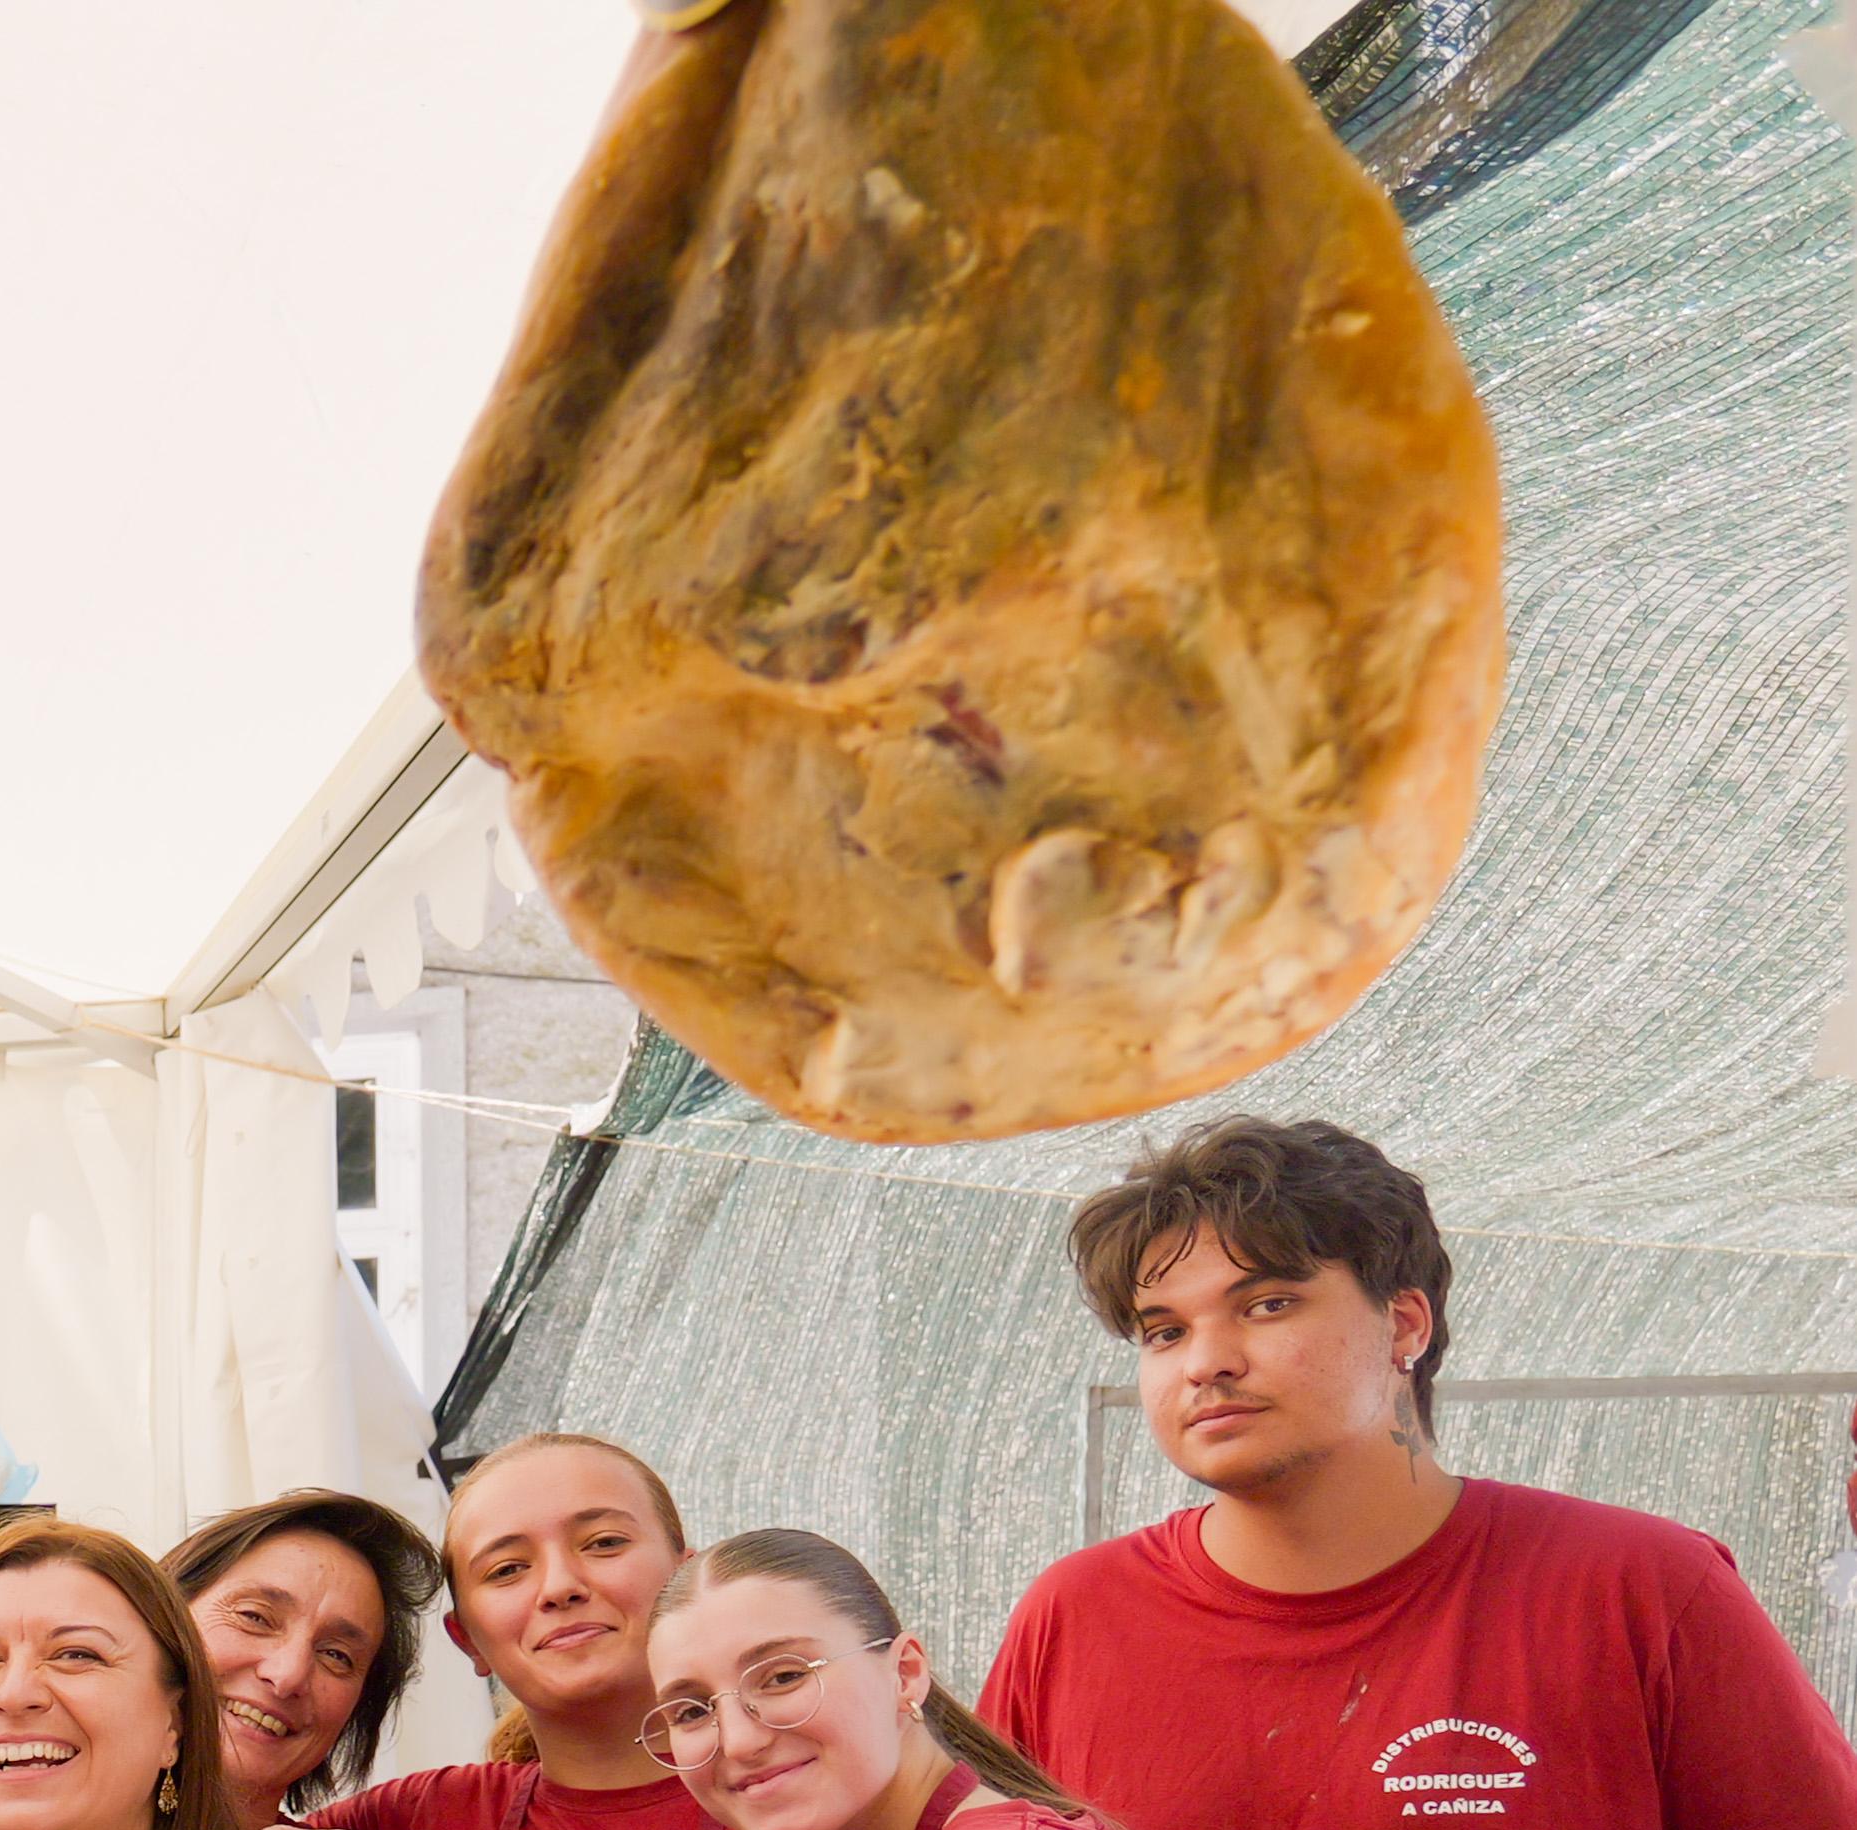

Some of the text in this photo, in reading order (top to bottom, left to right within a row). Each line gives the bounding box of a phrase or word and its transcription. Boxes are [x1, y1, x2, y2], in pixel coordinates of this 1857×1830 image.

[1371, 1718, 1537, 1774] DISTRIBUCIONES
[1383, 1771, 1526, 1793] RODRIGUEZ
[1401, 1797, 1506, 1816] A CAÑIZA
